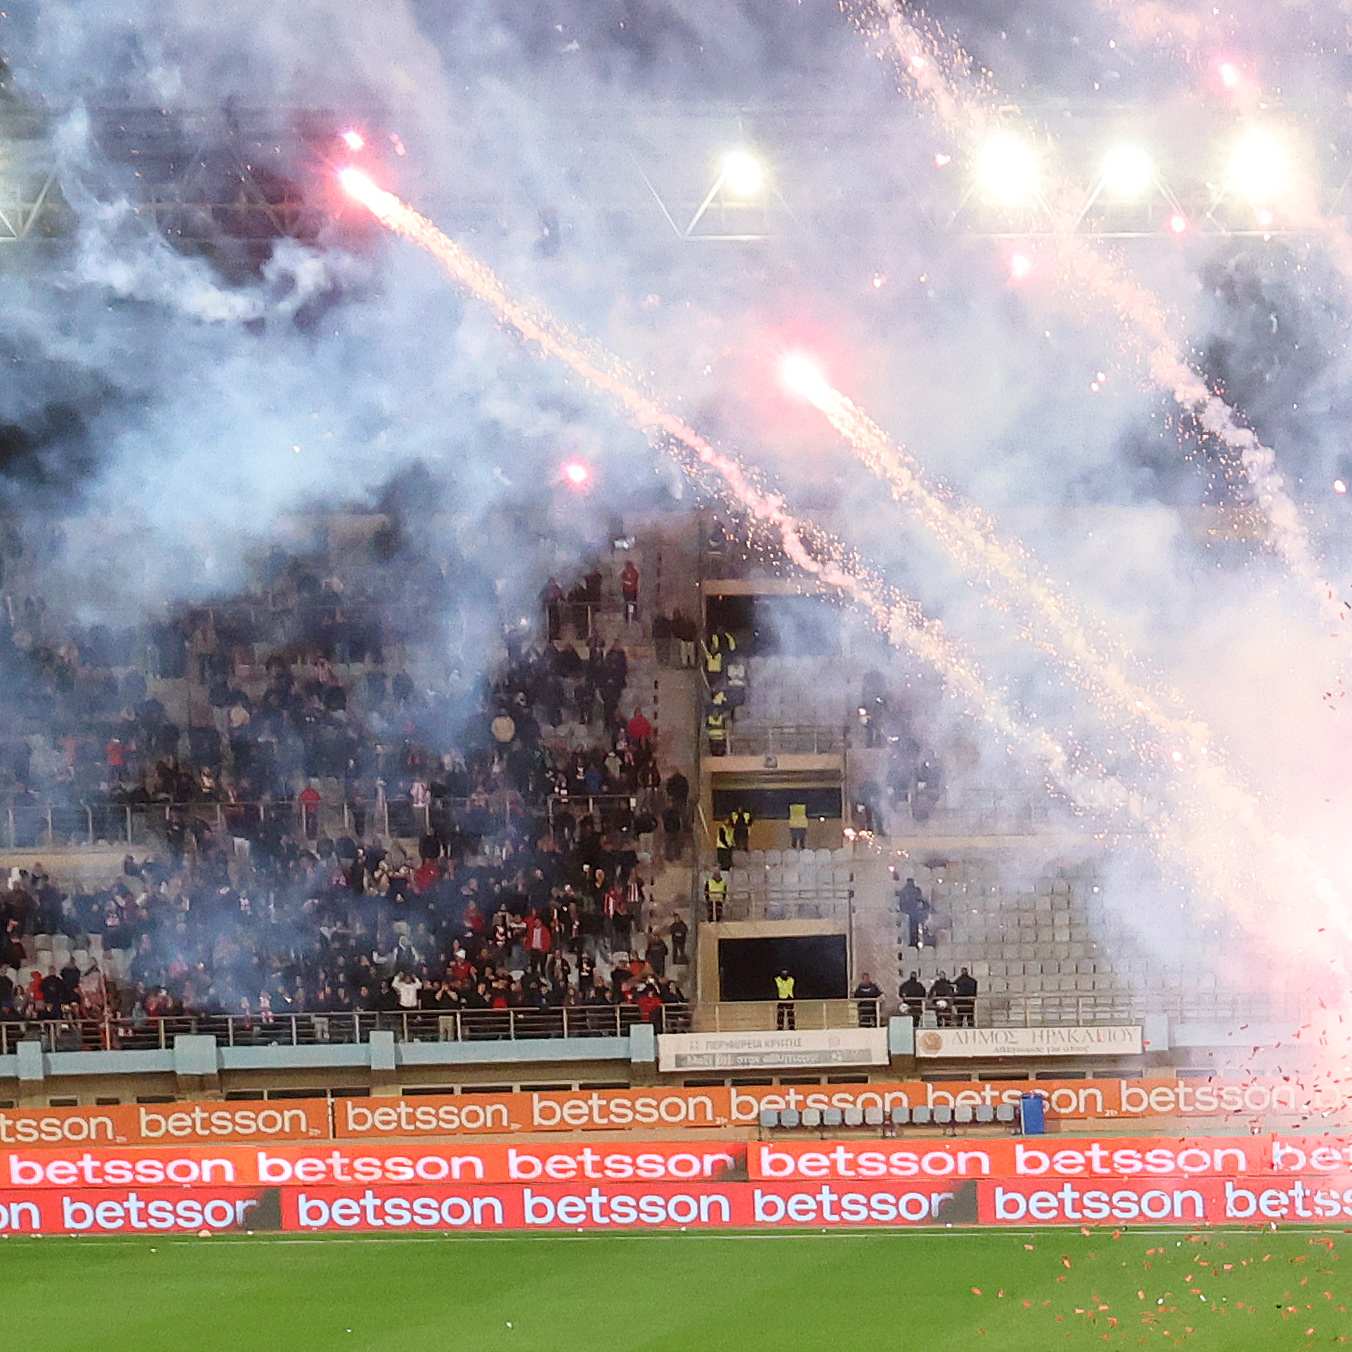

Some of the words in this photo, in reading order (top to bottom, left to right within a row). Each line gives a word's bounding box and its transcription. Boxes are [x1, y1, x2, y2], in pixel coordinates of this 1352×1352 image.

[141, 1107, 307, 1137] betsson
[347, 1101, 508, 1133] betsson
[533, 1092, 712, 1125] betsson
[9, 1154, 235, 1185] betsson
[257, 1151, 484, 1183] betsson
[760, 1146, 990, 1179] betsson
[1015, 1144, 1247, 1176] betsson
[297, 1191, 503, 1226] betsson
[523, 1187, 731, 1222] betsson
[994, 1183, 1205, 1219] betsson
